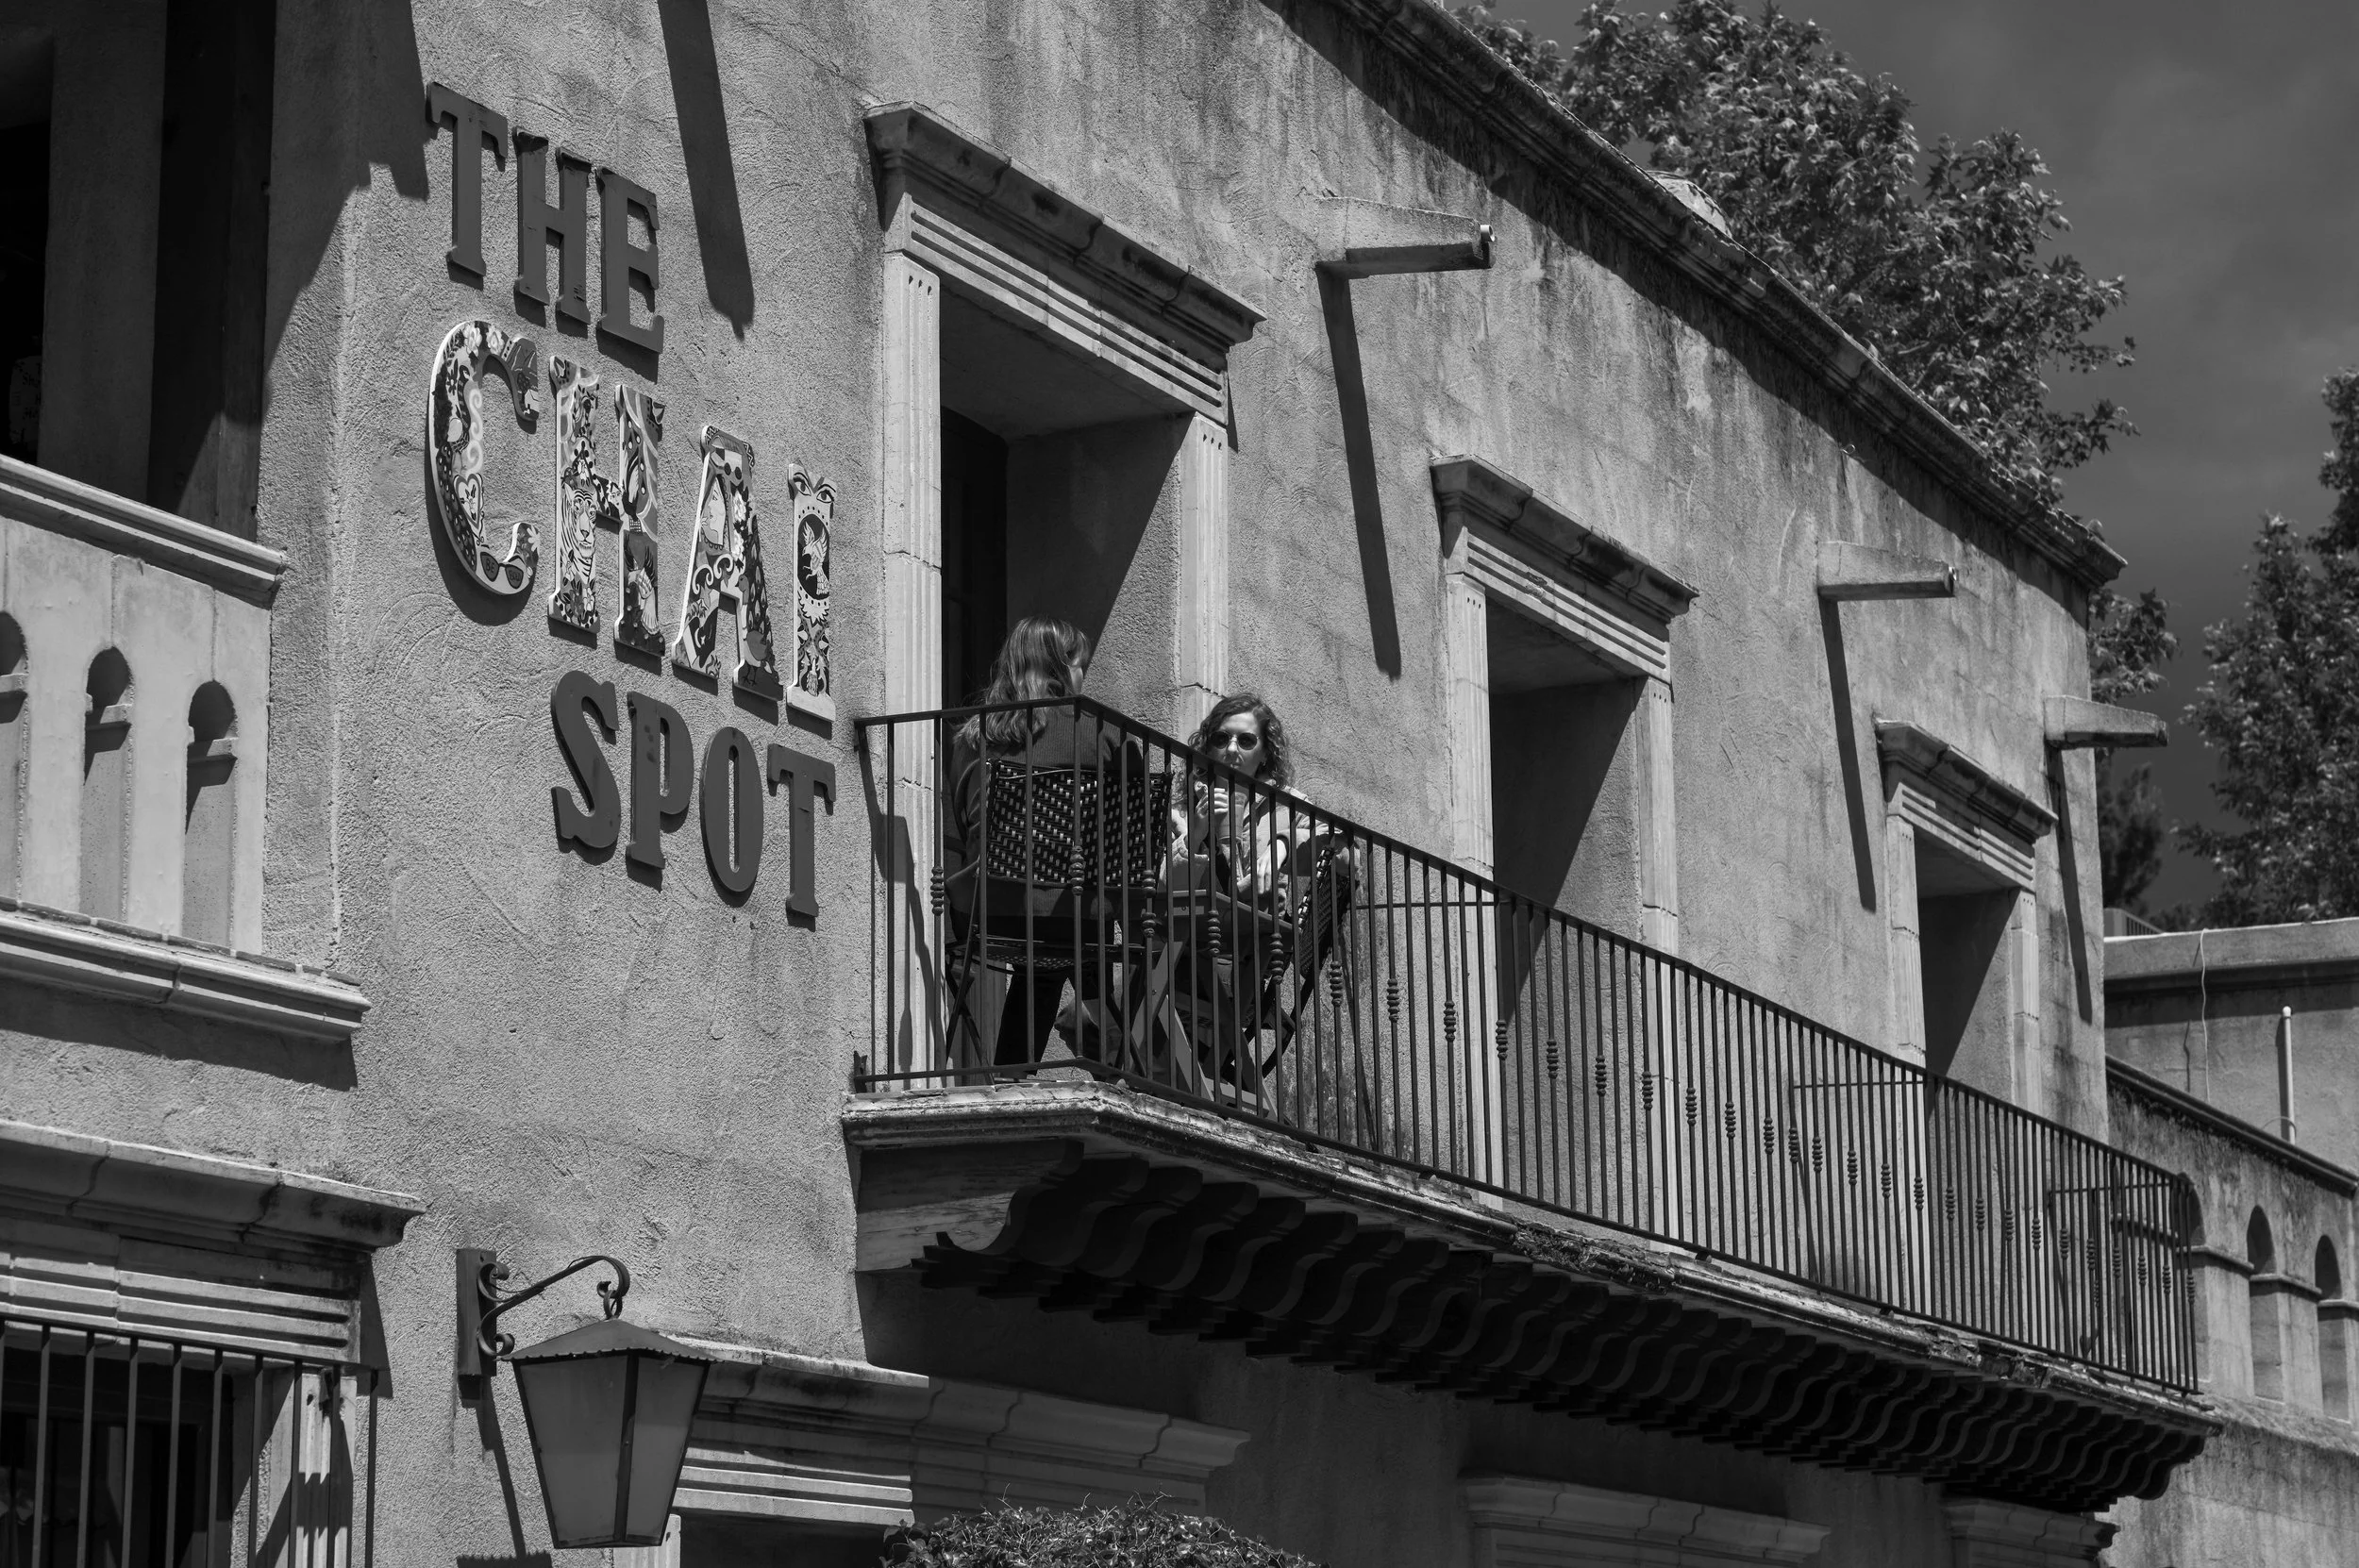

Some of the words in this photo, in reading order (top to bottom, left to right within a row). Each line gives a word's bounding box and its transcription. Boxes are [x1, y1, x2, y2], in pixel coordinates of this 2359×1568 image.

[427, 81, 664, 353] THE
[429, 321, 836, 721] CHAI
[551, 671, 836, 917] SPOT
